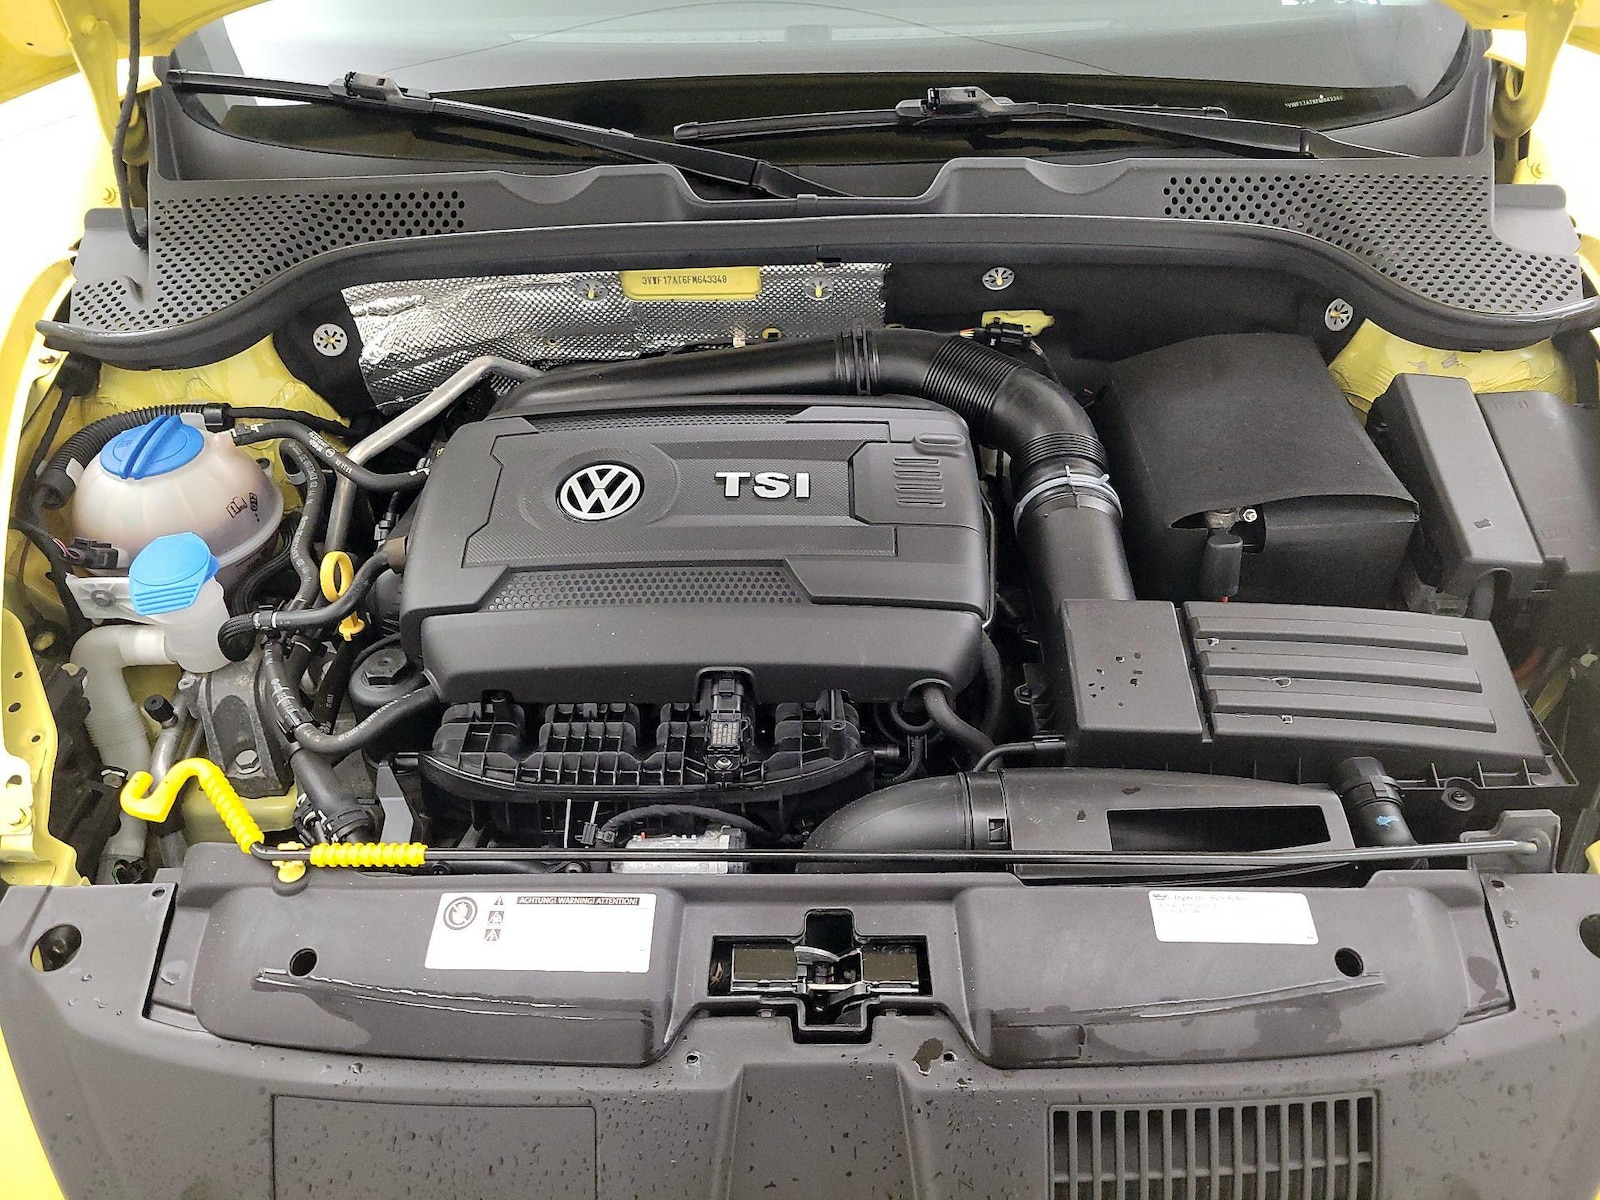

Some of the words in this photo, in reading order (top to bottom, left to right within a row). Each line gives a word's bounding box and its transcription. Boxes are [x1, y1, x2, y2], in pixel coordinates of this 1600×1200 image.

[559, 463, 642, 521] VW
[715, 471, 811, 499] TSI
[518, 896, 557, 904] ACHTUNG!
[558, 896, 595, 905] WARNING!
[595, 897, 638, 905] ATTENTION!
